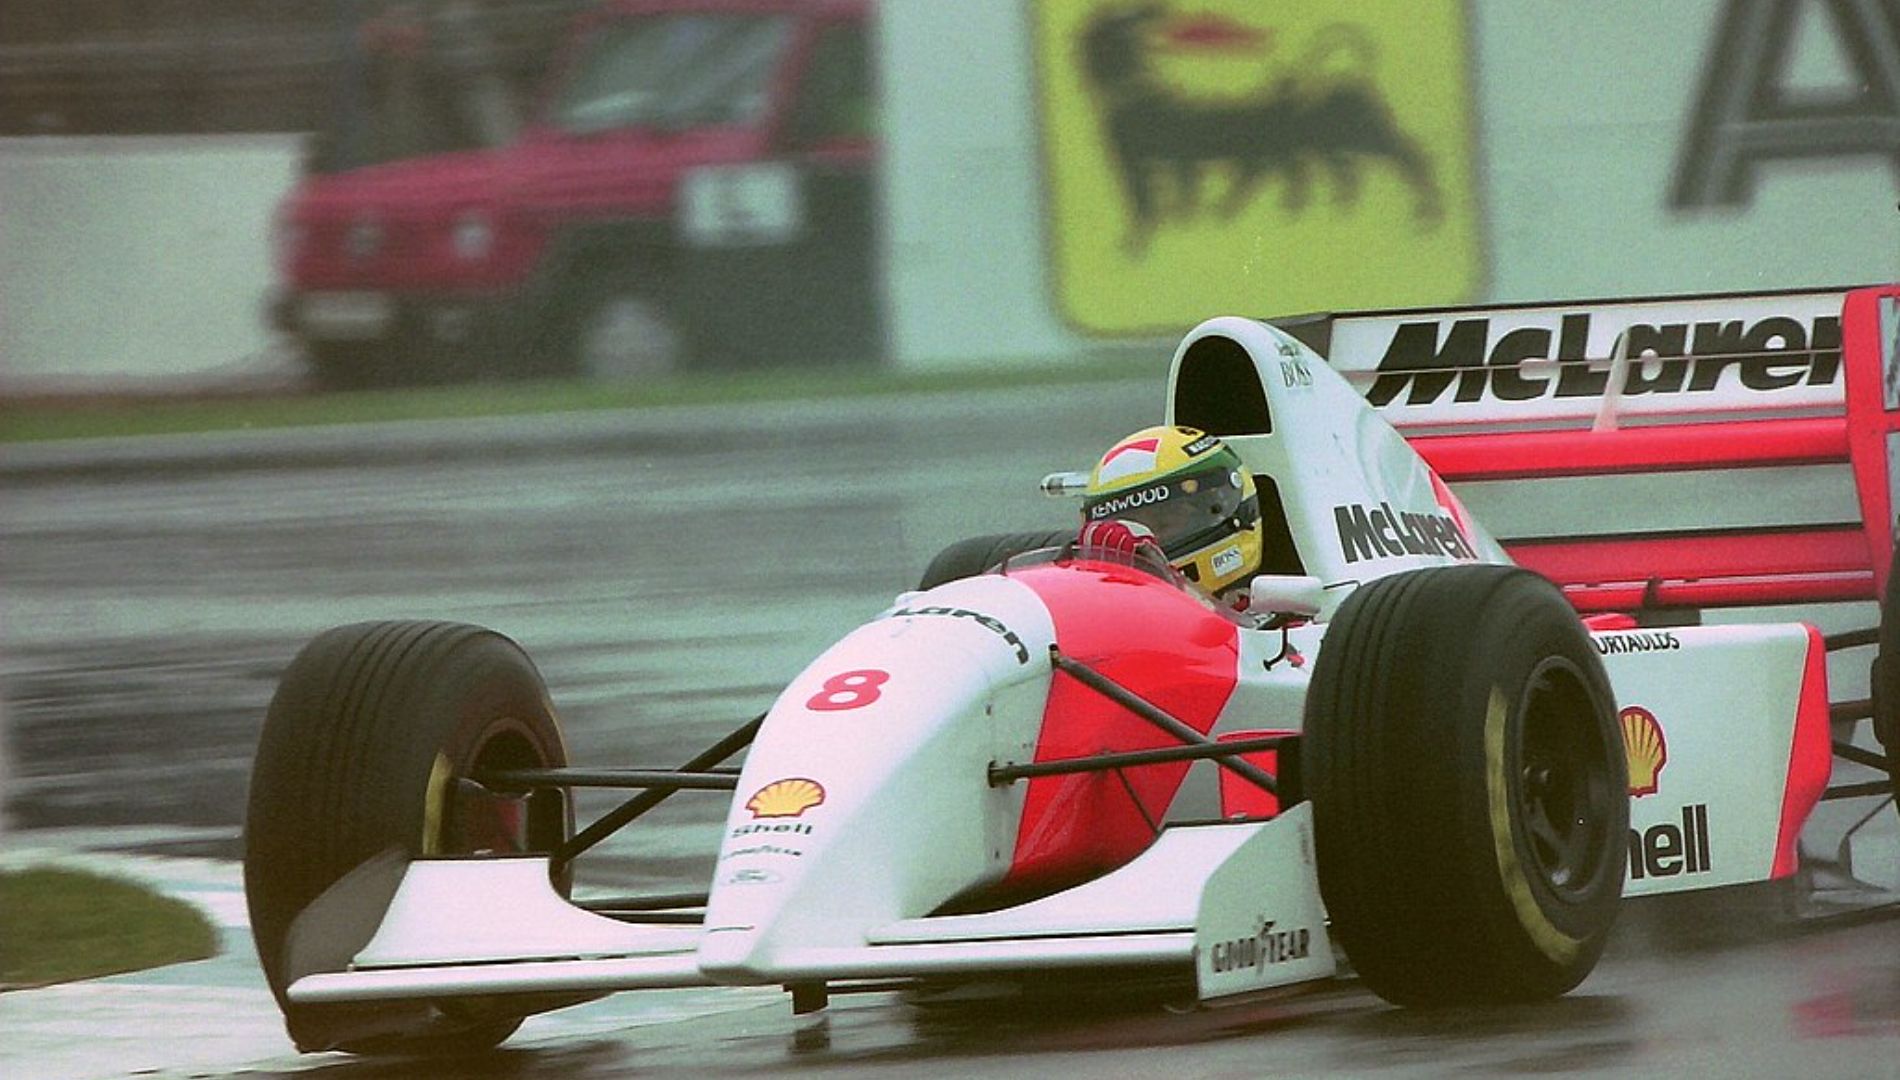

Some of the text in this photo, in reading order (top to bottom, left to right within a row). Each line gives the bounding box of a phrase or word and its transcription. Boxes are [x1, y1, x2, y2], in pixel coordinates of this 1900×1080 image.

[1092, 485, 1169, 519] KENWOOD
[1334, 501, 1478, 563] McLaren
[892, 606, 1029, 664] Laren
[1592, 632, 1680, 655] URTAULDS
[805, 669, 890, 711] 8
[732, 824, 813, 838] Shell
[1627, 805, 1710, 879] ell
